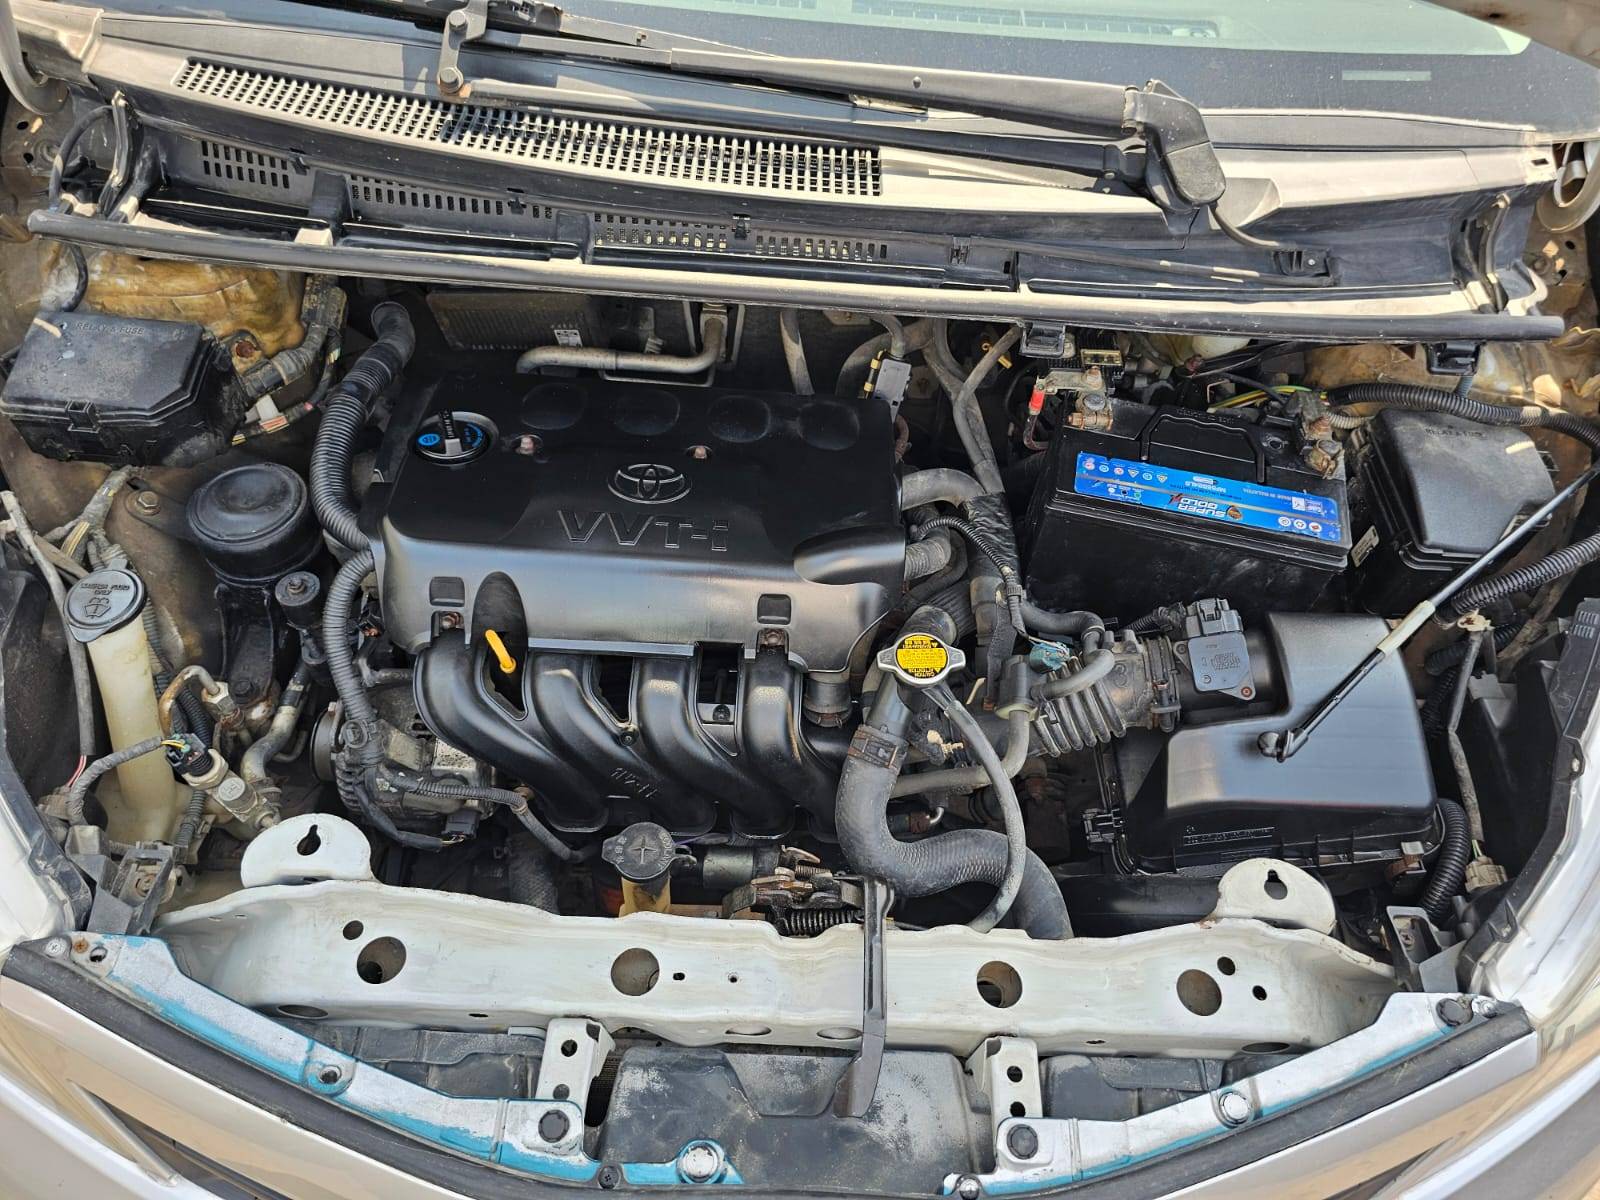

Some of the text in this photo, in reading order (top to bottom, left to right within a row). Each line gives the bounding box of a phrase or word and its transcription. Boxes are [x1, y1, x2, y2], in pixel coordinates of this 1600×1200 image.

[119, 326, 145, 335] FUSE
[1180, 497, 1218, 510] GOLD
[1178, 503, 1226, 518] SUPER
